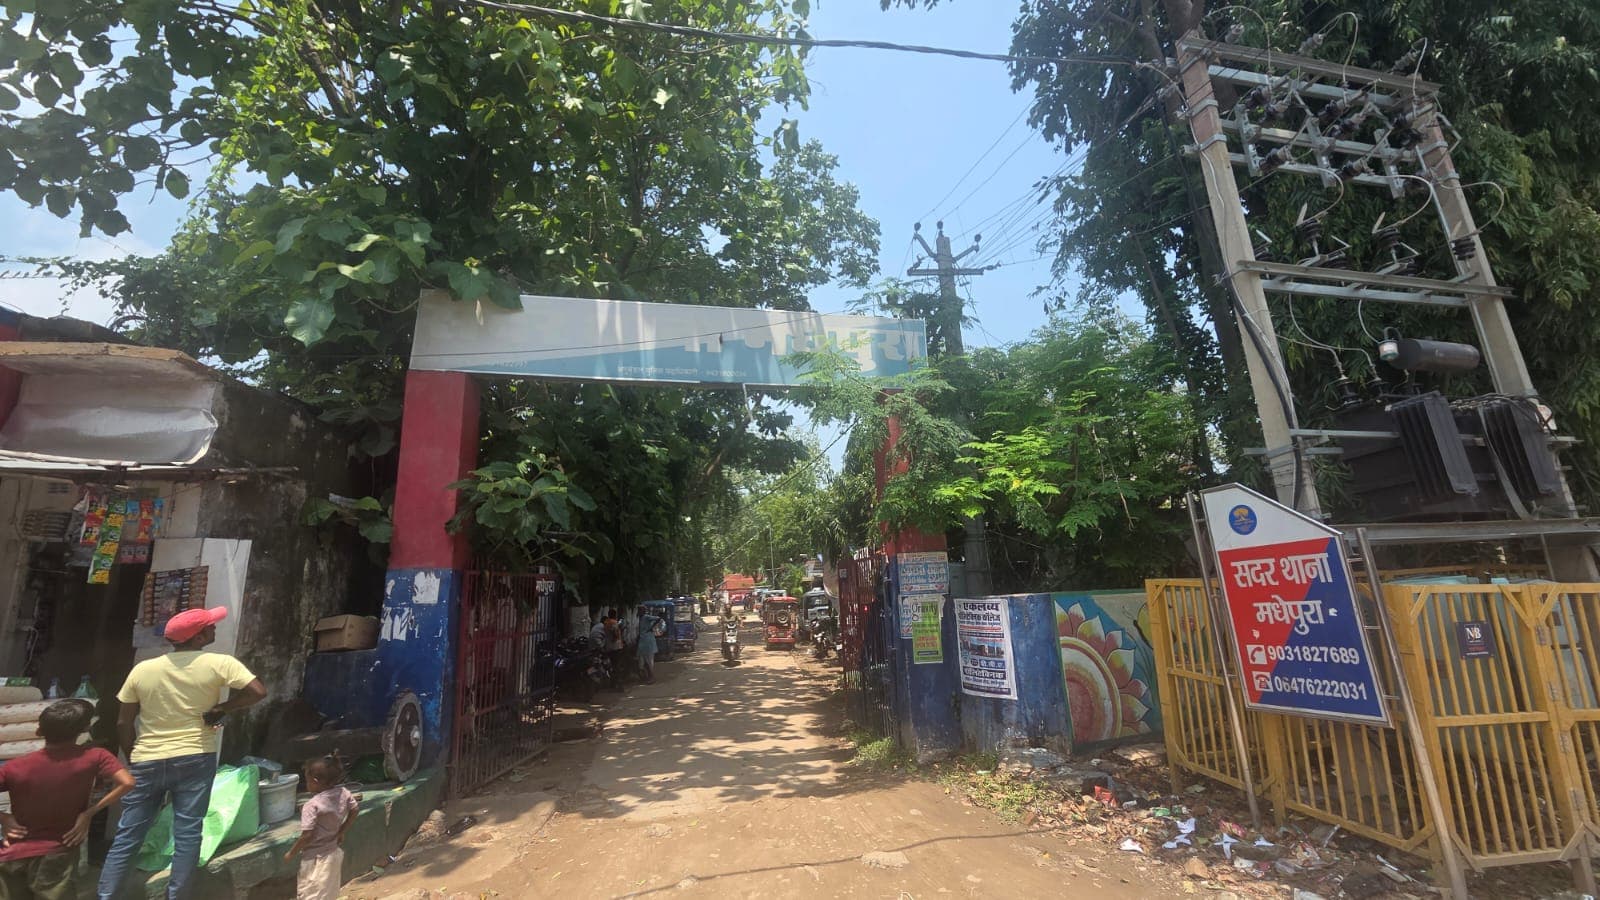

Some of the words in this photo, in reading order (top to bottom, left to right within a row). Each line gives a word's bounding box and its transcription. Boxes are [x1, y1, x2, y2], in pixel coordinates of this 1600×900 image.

[1231, 558, 1280, 588] सदर
[1280, 553, 1334, 585] थाना
[1253, 595, 1325, 635] मधेपुरा
[1268, 645, 1360, 665] 9031827689
[1274, 675, 1368, 700] 06476222031
